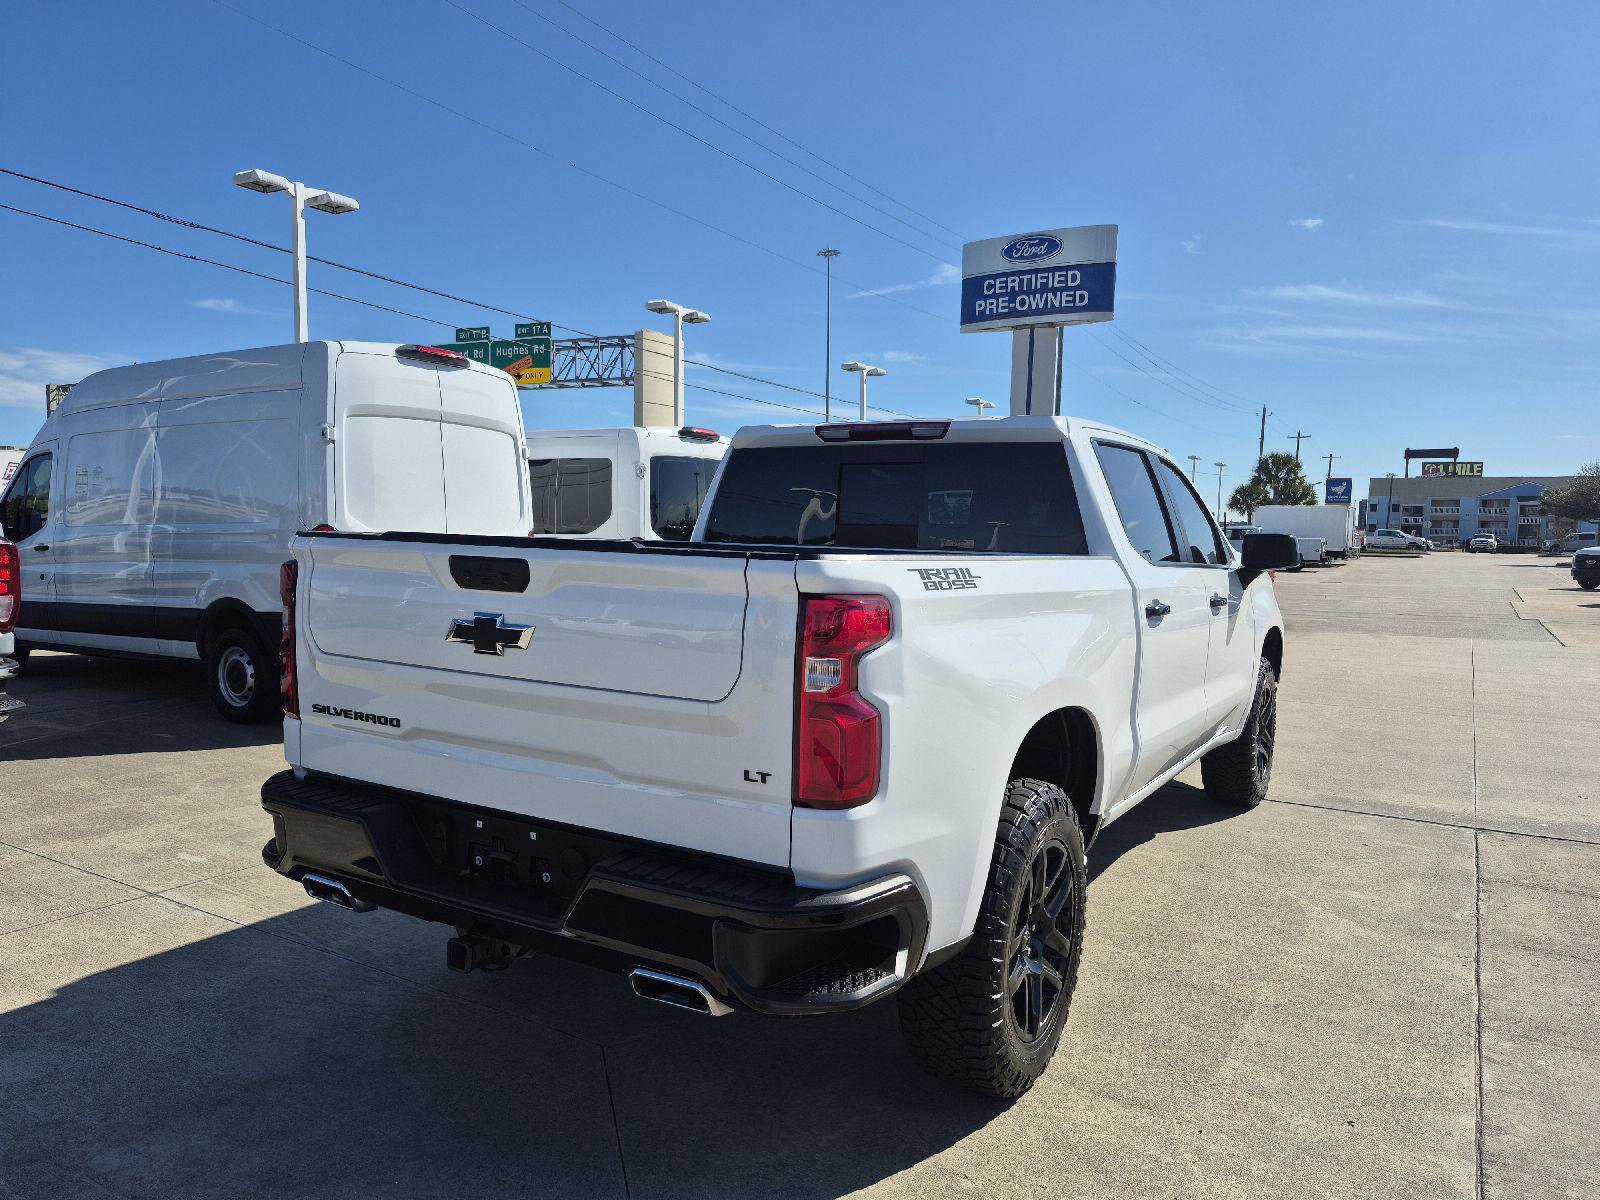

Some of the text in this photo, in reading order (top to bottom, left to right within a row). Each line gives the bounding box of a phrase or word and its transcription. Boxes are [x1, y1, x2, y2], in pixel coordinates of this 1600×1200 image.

[1013, 239, 1049, 258] Ford
[983, 270, 1081, 296] CERTIFIED
[975, 290, 1089, 317] PRE-OWNED
[473, 349, 484, 359] Rd
[496, 344, 545, 358] Hughes Rd
[525, 371, 544, 379] ONLY
[907, 567, 982, 581] TRAIL
[923, 579, 978, 591] BOSS
[312, 703, 401, 728] SILVERADO
[743, 769, 772, 785] LT
